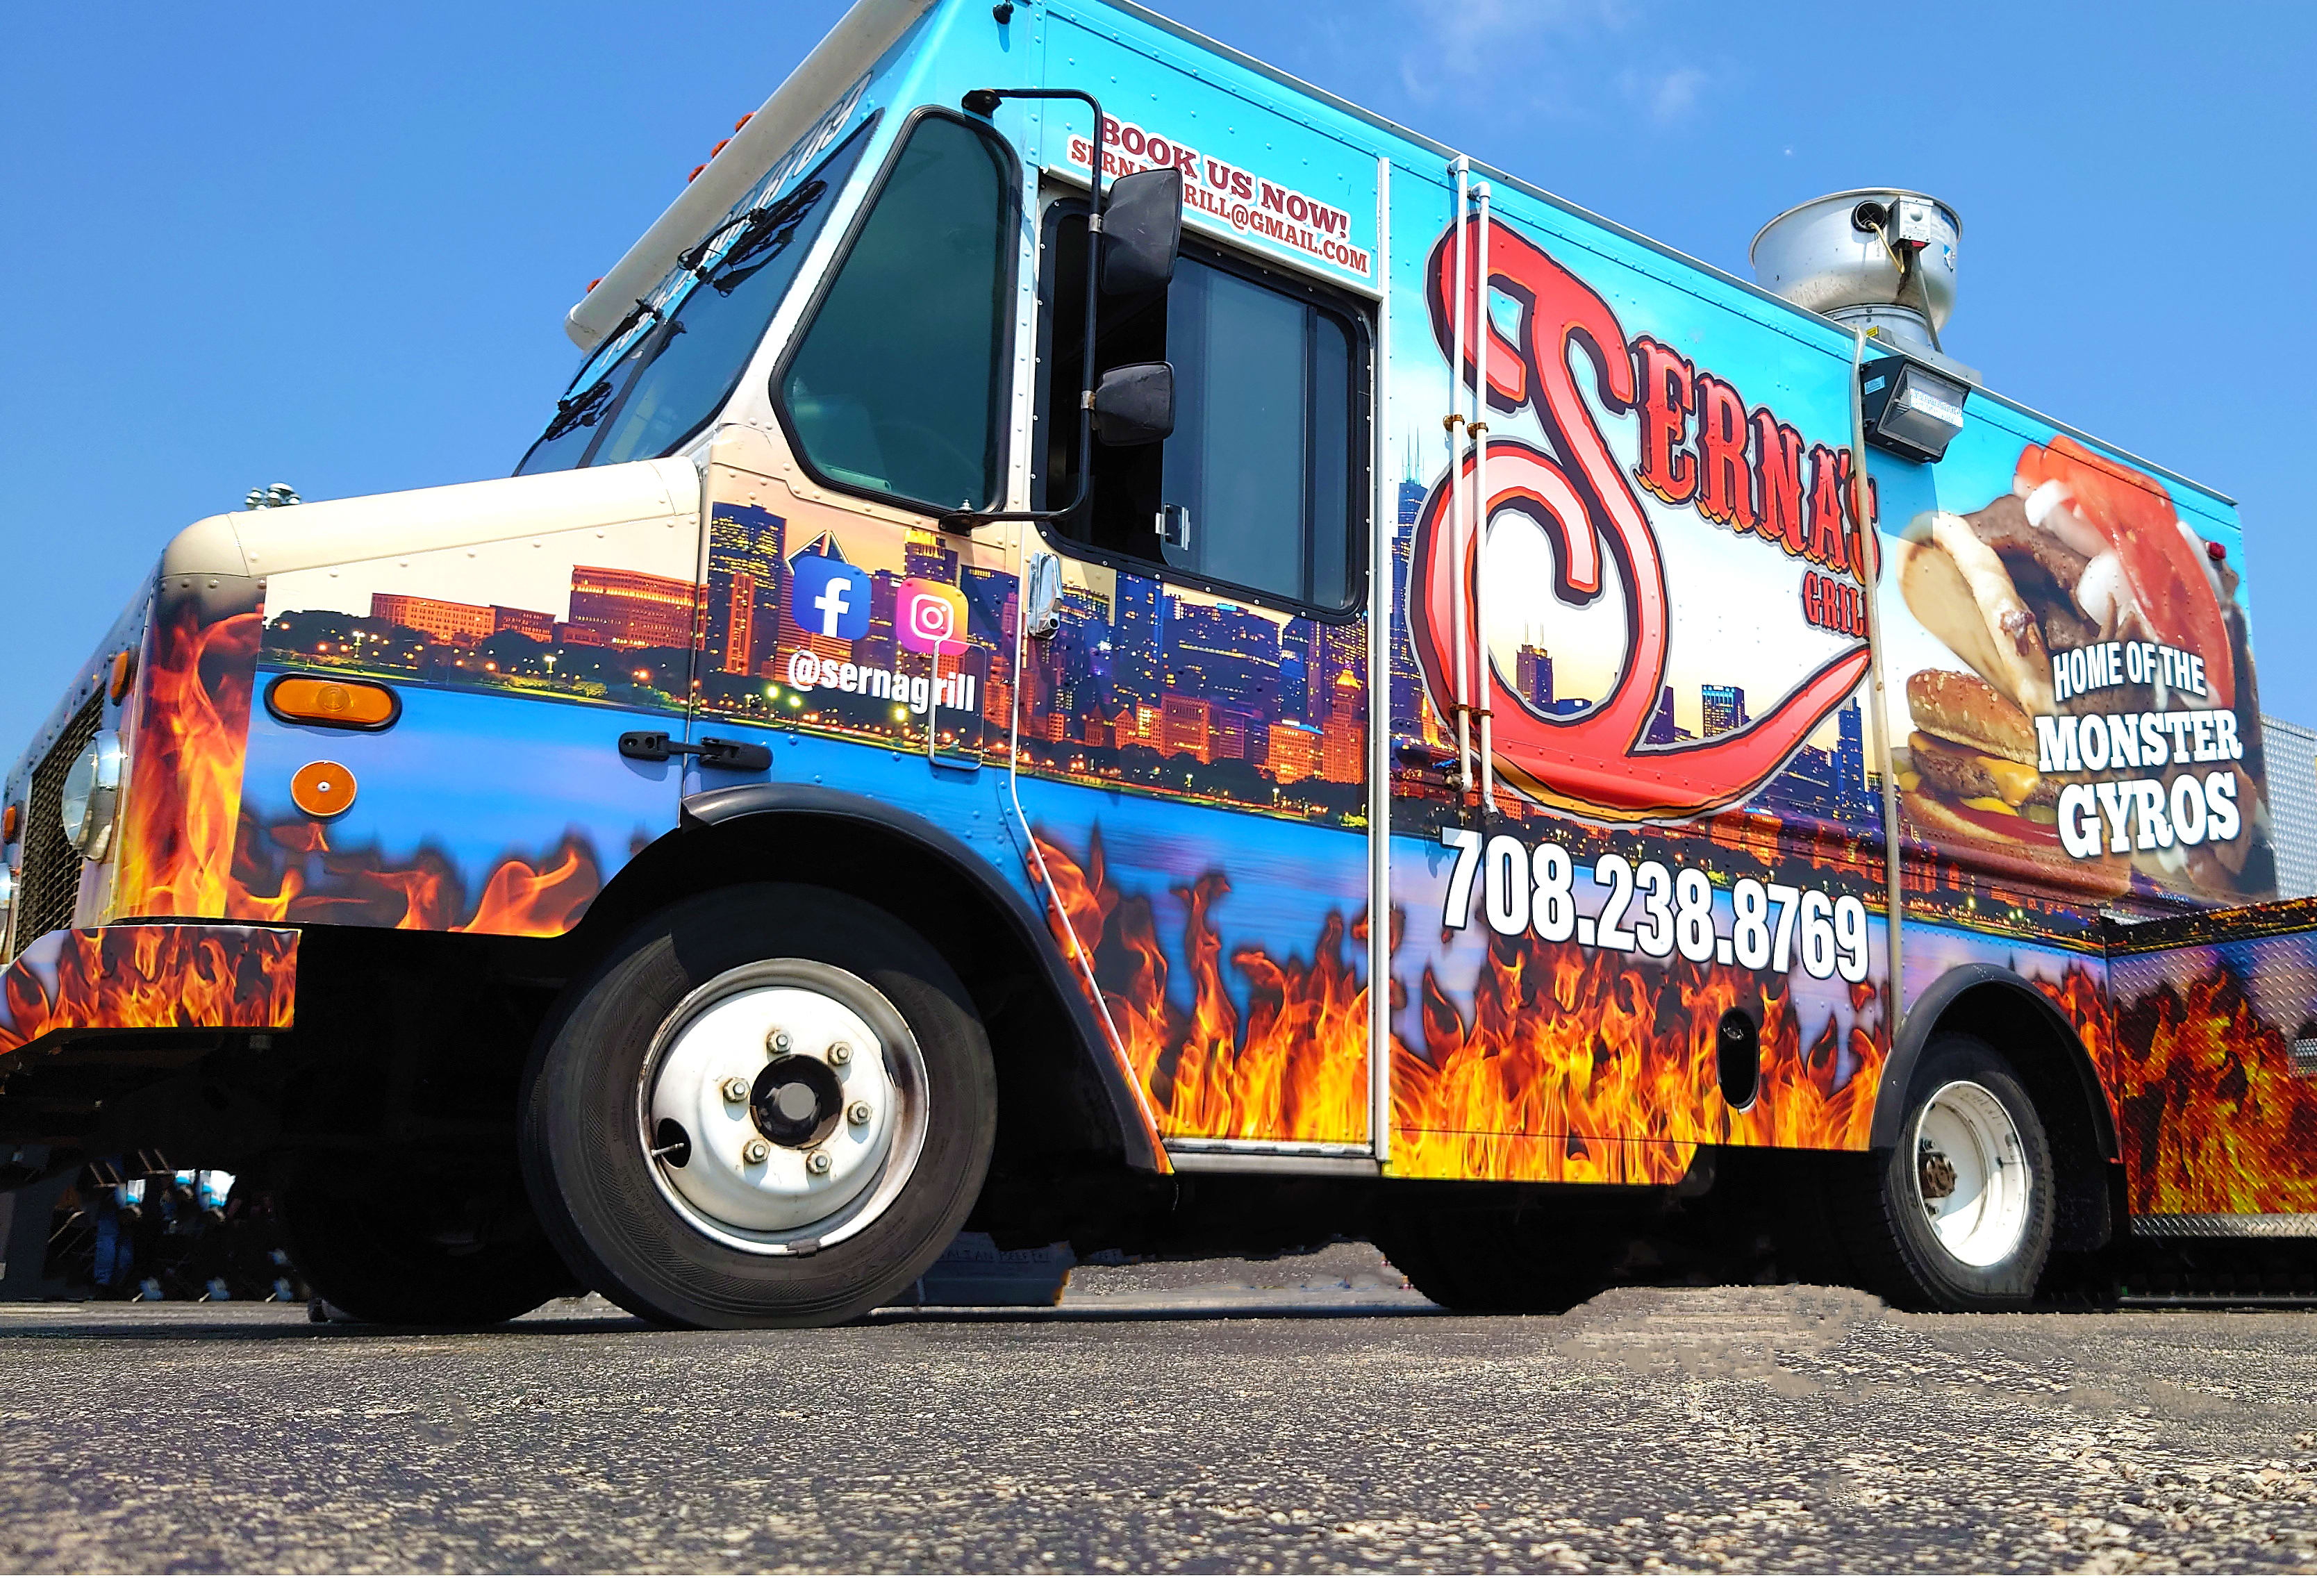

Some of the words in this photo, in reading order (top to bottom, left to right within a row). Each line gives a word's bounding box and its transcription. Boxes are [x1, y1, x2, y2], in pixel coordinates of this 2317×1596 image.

[1071, 139, 1368, 273] SRNRILL@GMAIL.COM
[1102, 117, 1197, 180] BOOK
[1206, 160, 1252, 200] US
[1261, 184, 1349, 239] NOW!
[788, 650, 976, 715] @sernagrill
[2052, 641, 2125, 702] HOME
[2126, 640, 2157, 684] OF
[2159, 645, 2207, 697] THE
[2034, 709, 2243, 773] MONSTER
[2057, 772, 2241, 859] GYROS
[1441, 826, 1870, 984] 708.238.8769
